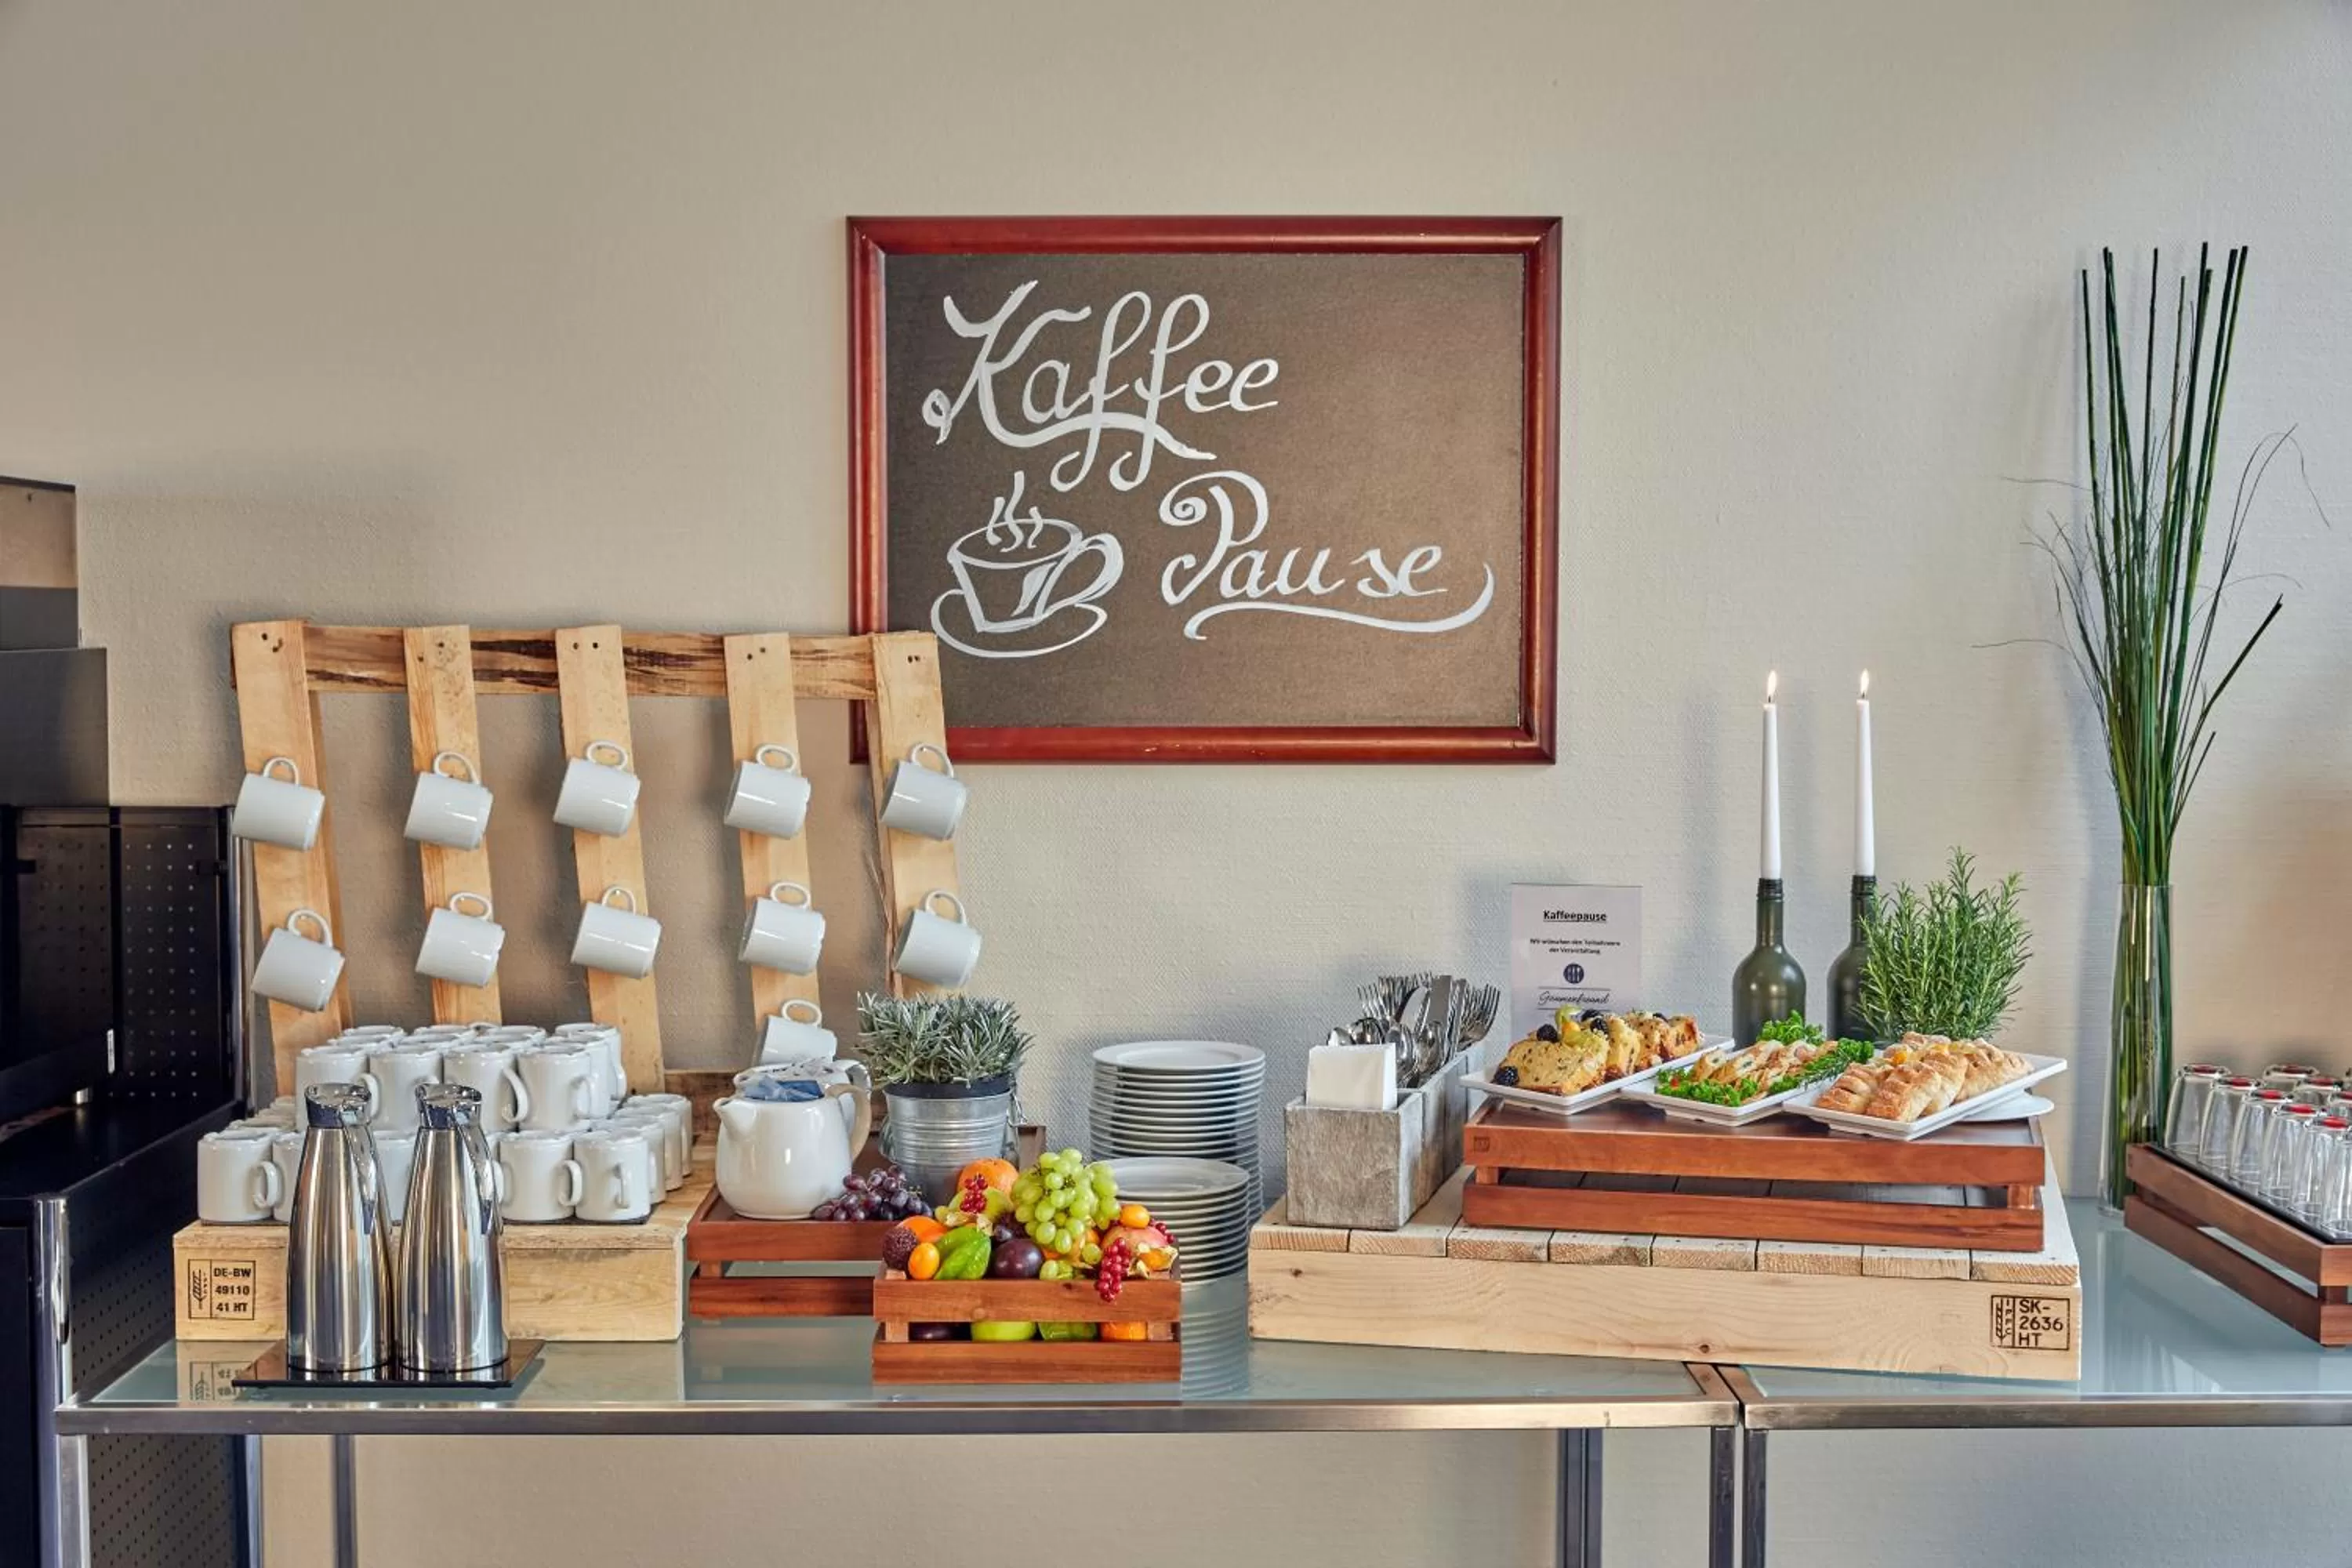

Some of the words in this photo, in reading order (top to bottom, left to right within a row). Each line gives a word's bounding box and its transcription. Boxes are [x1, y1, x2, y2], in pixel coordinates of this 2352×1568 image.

[923, 280, 1279, 492] Kaffee
[1159, 470, 1447, 605] Pause
[1543, 910, 1606, 922] Kaffeepause
[214, 1268, 252, 1277] DE-BW
[215, 1285, 250, 1295] 49110
[216, 1302, 229, 1312] 41
[234, 1302, 249, 1312] HT
[2019, 1299, 2051, 1314] SK-
[2019, 1316, 2063, 1331] 2636
[2019, 1332, 2042, 1346] HT
